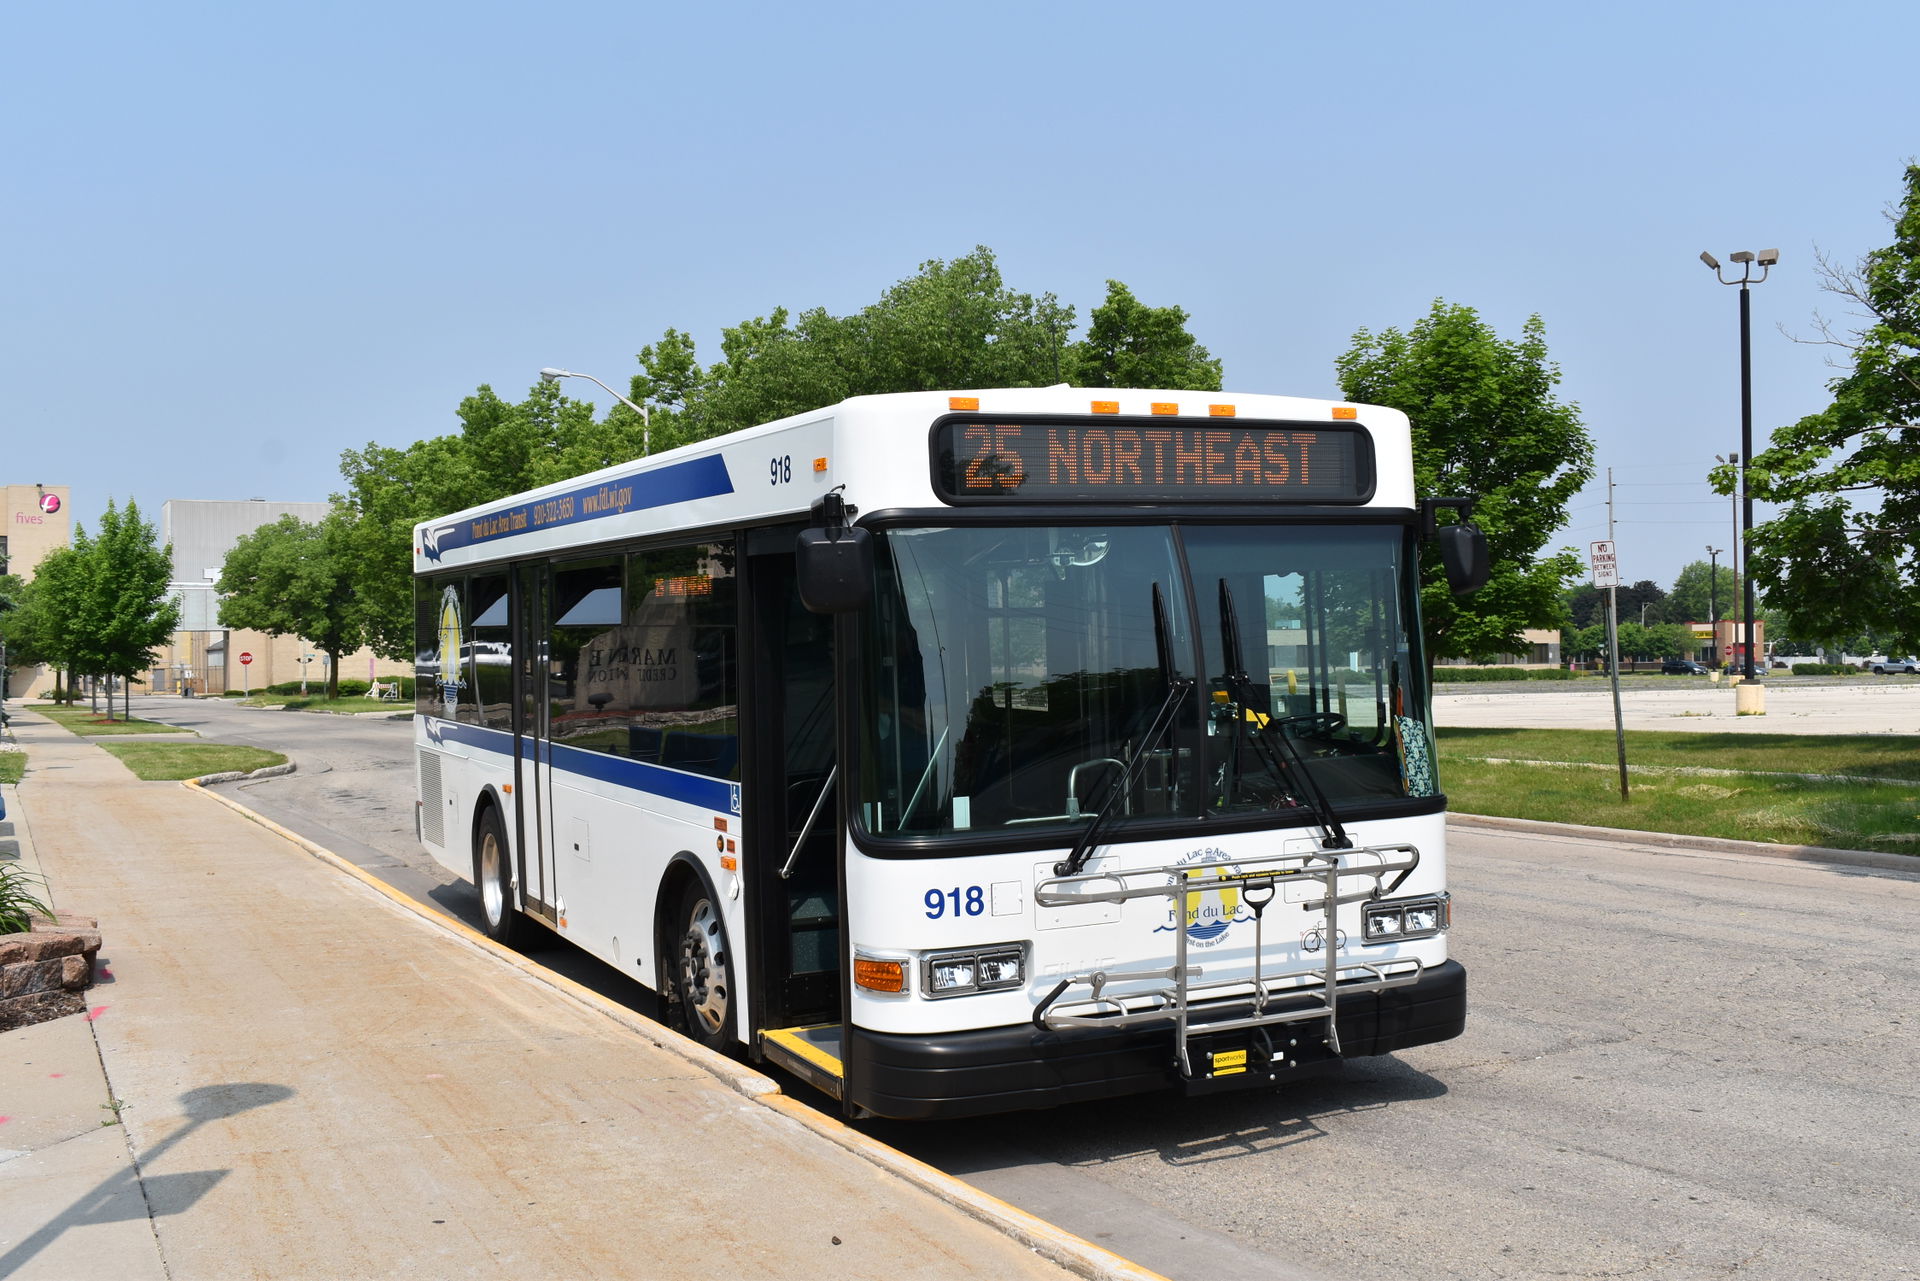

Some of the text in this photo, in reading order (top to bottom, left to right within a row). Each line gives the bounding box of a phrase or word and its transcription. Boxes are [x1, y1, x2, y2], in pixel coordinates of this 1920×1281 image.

[964, 424, 1317, 489] 25 NORTHEAST
[770, 454, 791, 486] 918
[16, 511, 43, 524] fives
[509, 508, 527, 530] Transit
[1597, 543, 1607, 553] NO
[1592, 553, 1615, 563] PARKING
[1594, 563, 1615, 571] BETWEEN
[1186, 848, 1203, 860] Lac
[924, 885, 985, 920] 918
[1168, 903, 1244, 922] Fnd du Lac
[1215, 931, 1230, 944] Lake
[1214, 1053, 1246, 1063] sportworks
